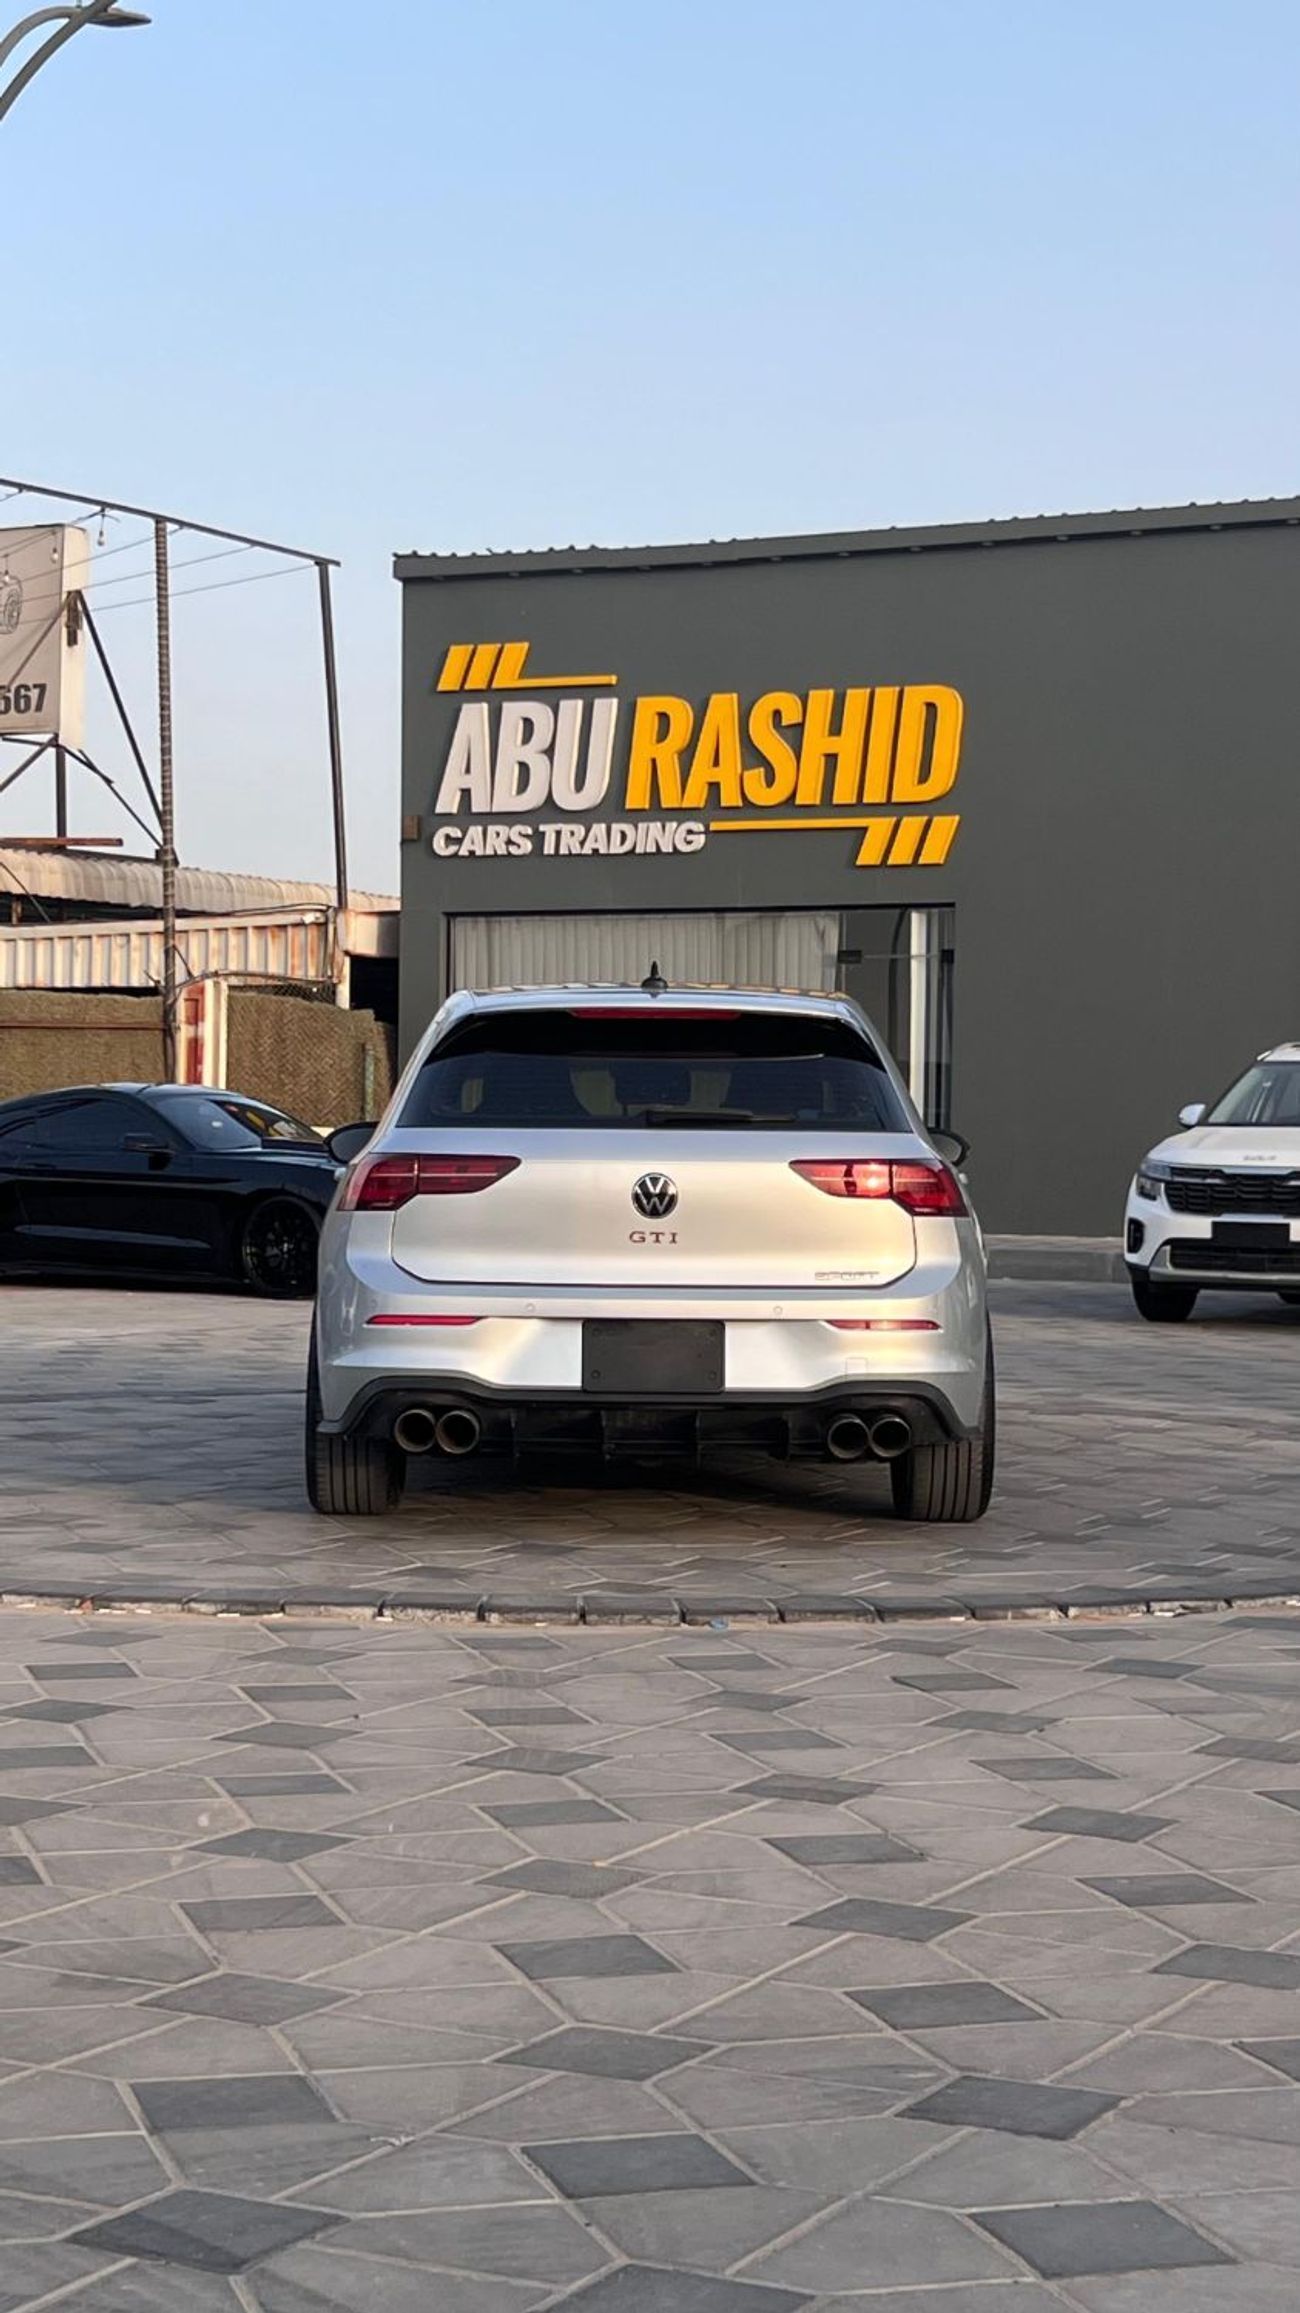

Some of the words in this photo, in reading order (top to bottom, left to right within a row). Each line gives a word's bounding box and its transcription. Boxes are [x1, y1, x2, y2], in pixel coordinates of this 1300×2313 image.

[434, 697, 618, 814] ABU
[624, 684, 964, 811] RASHID
[432, 825, 534, 857] CARS
[538, 821, 706, 856] TRADING
[629, 1230, 678, 1244] GTI
